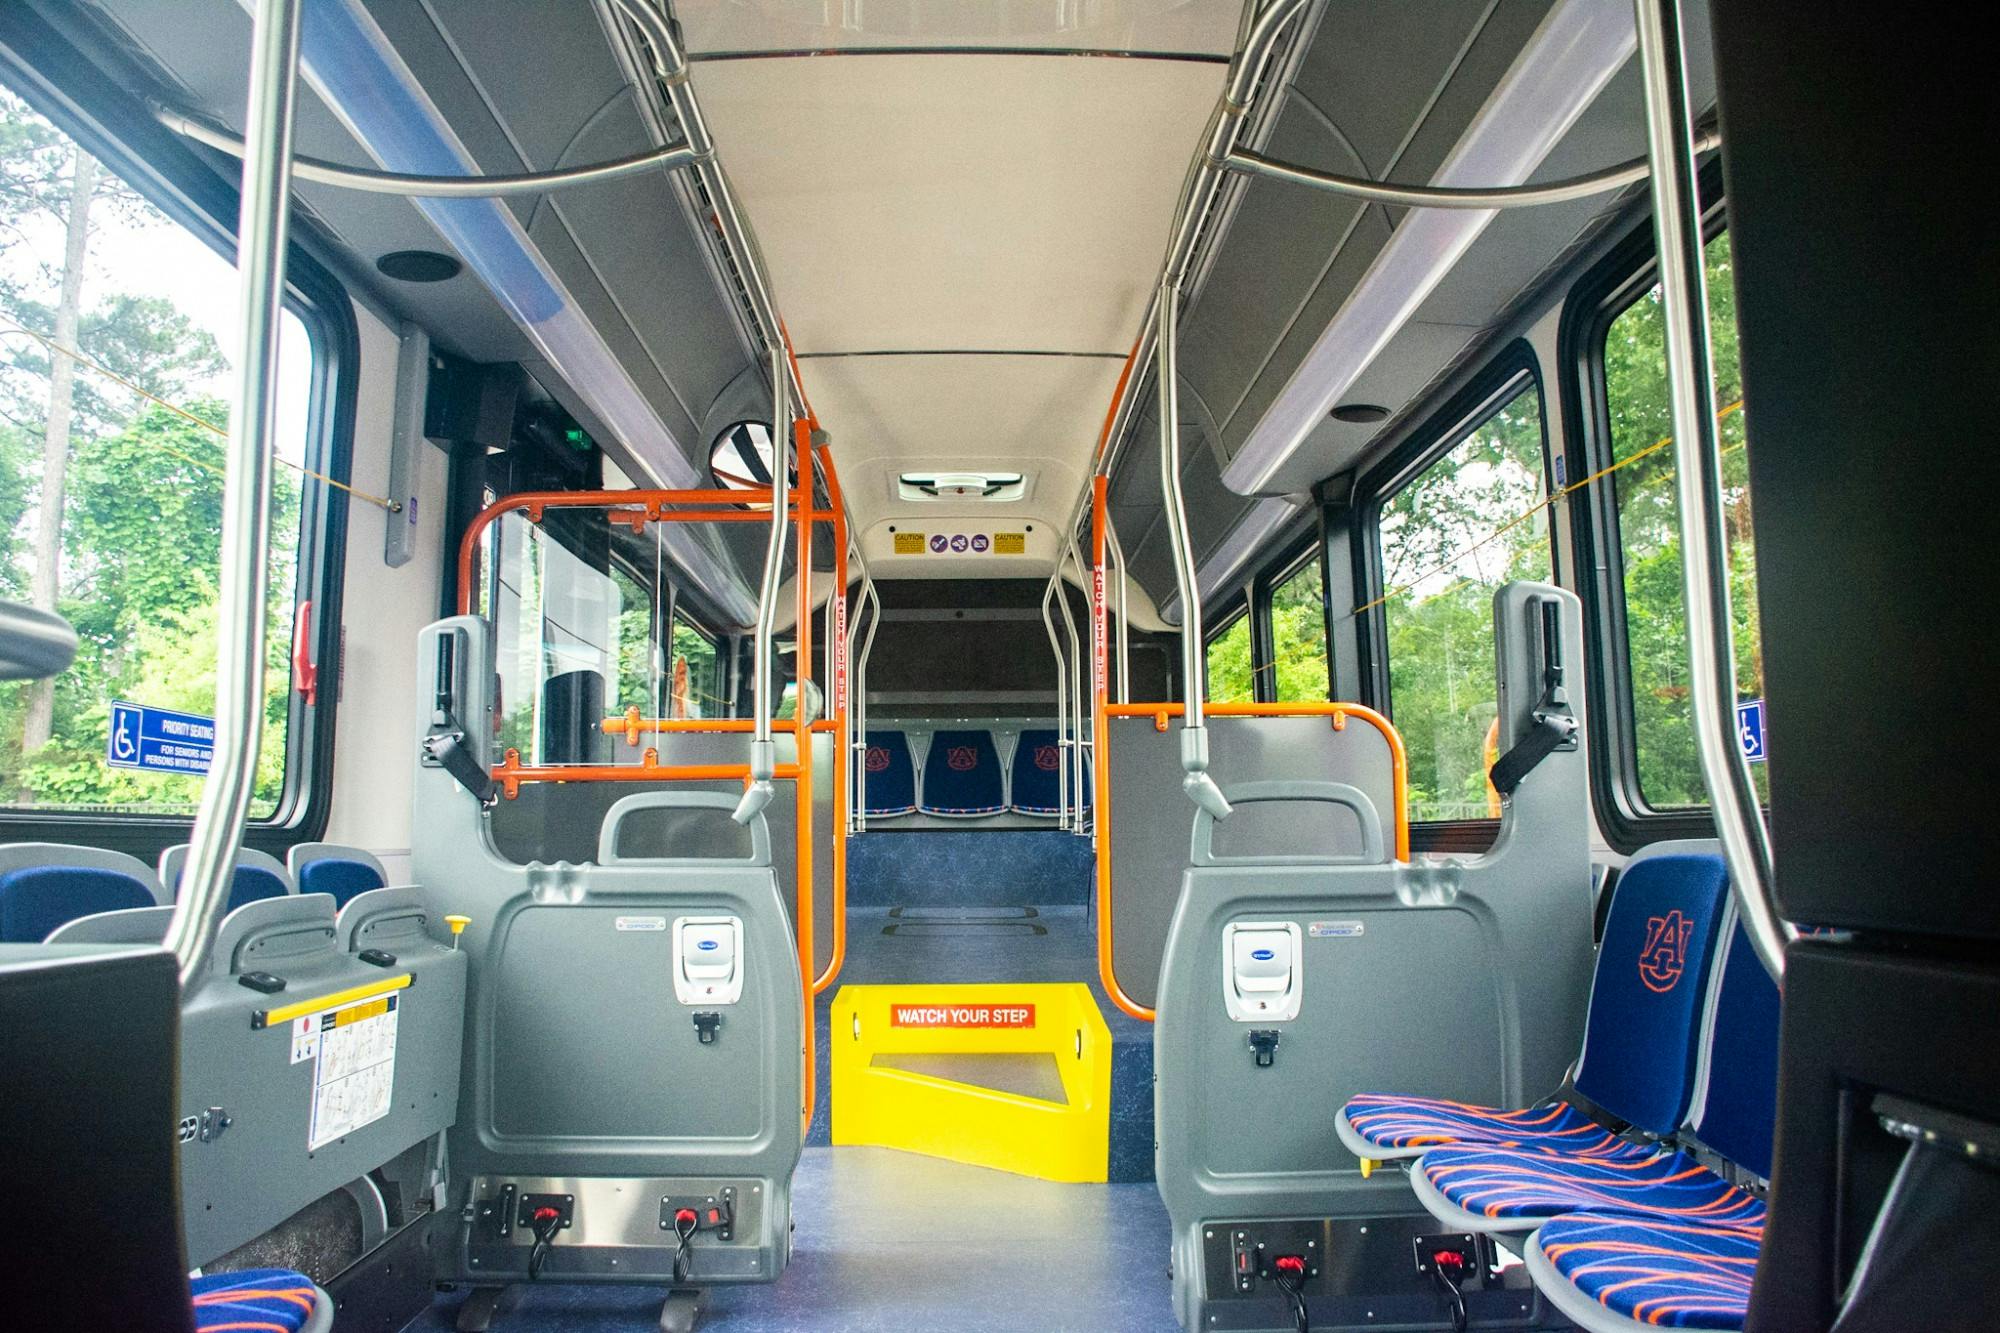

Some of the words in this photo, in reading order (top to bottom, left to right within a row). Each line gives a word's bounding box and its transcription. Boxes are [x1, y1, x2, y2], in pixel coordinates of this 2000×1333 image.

[1095, 565, 1104, 609] WATCH
[1096, 656, 1104, 689] STEP
[162, 720, 189, 736] PRIORITY
[190, 724, 214, 740] SEATING
[144, 754, 175, 767] PERSONS
[161, 744, 174, 755] FOR
[175, 746, 200, 759] SENIORS
[200, 750, 213, 760] AND
[897, 1009, 947, 1023] WATCH
[950, 1009, 989, 1023] YOUR
[993, 1009, 1028, 1023] STEP
